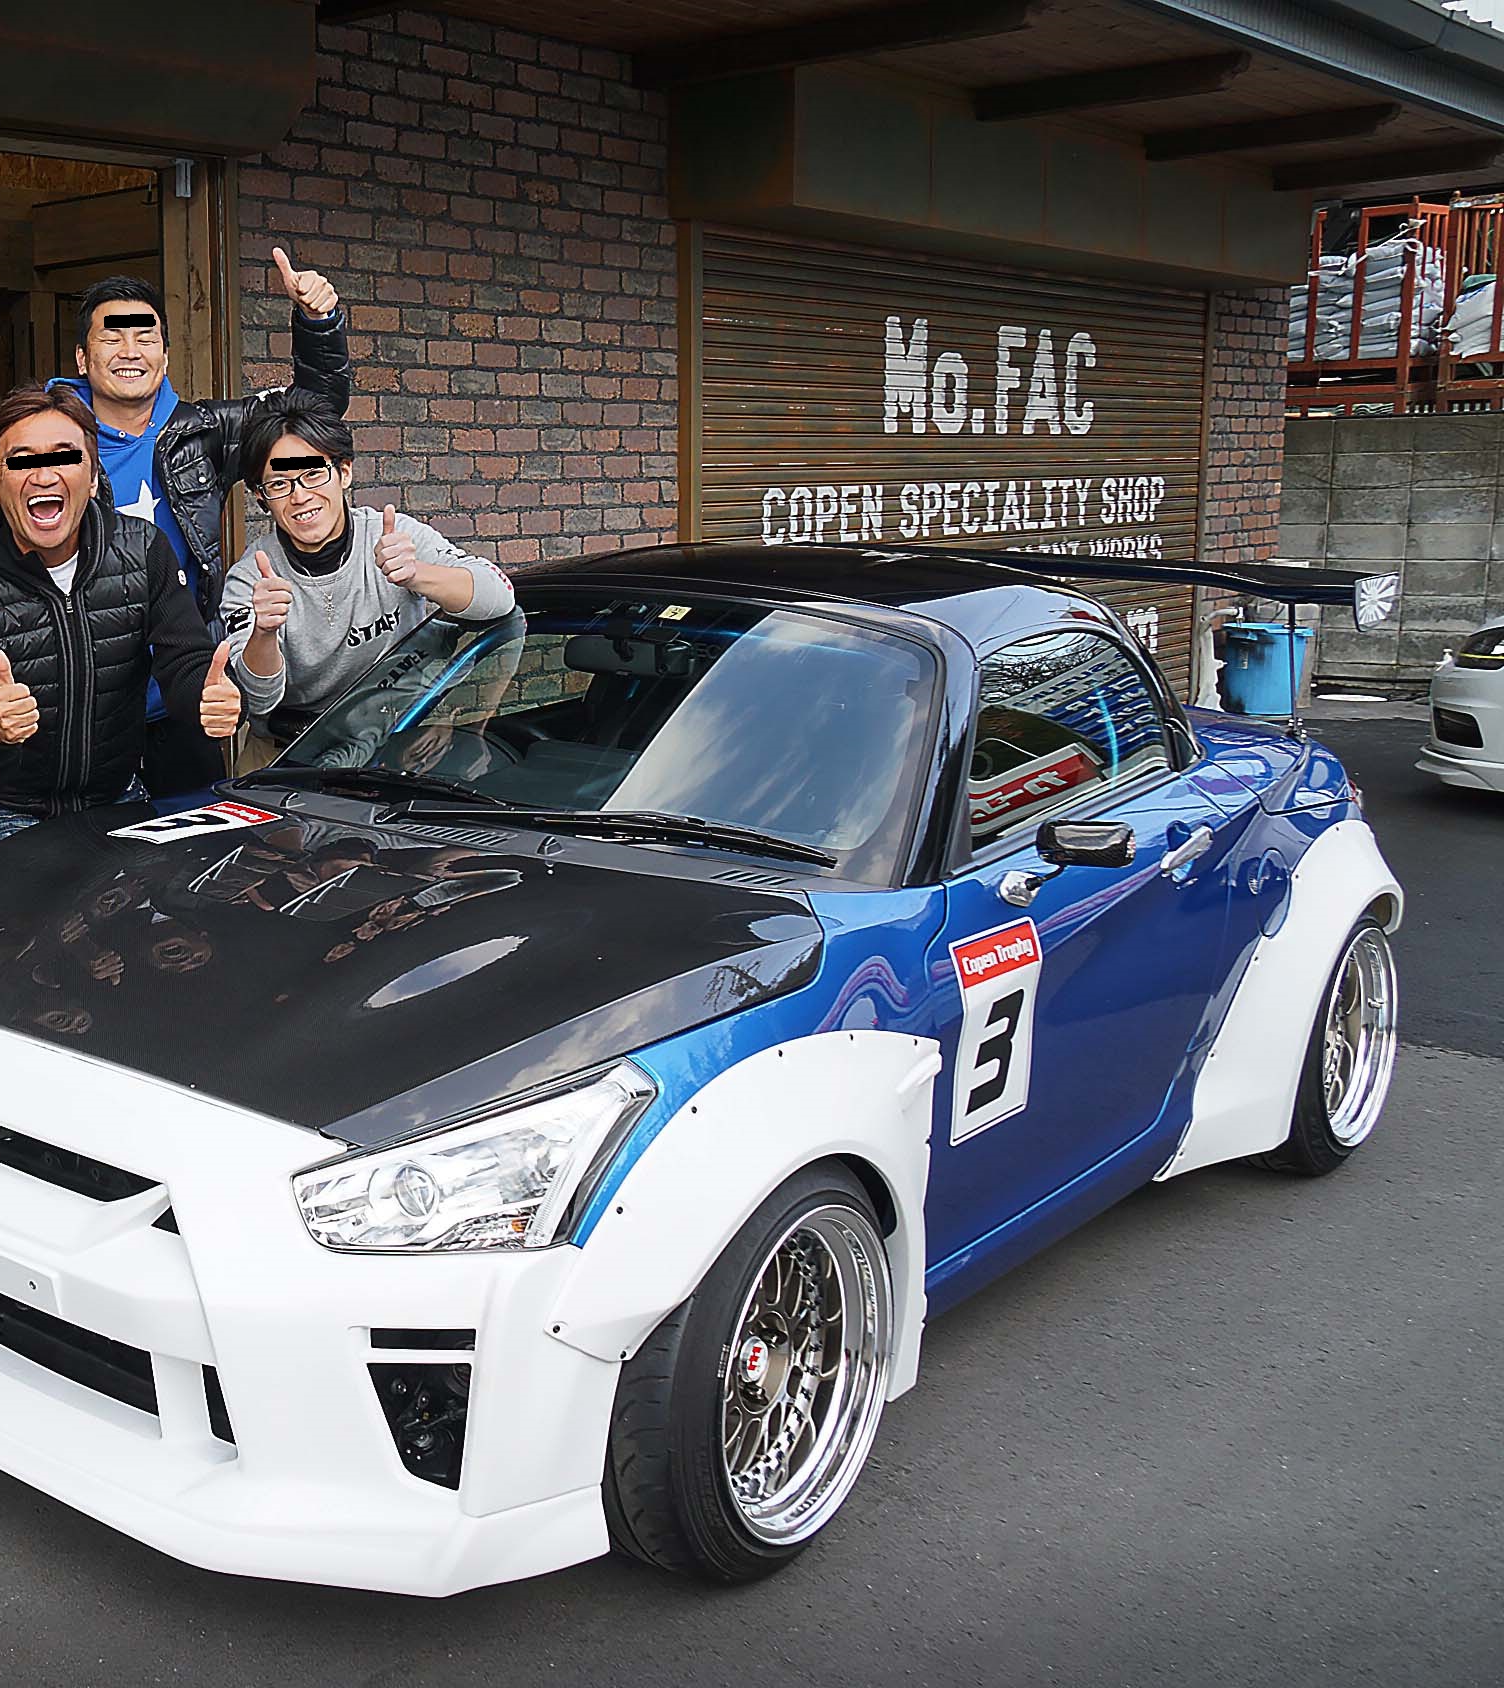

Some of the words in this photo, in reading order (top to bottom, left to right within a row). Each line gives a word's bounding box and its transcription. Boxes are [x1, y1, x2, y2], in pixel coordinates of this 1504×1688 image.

[883, 315, 1097, 436] Mo.FAC
[761, 484, 884, 546] COPEN
[899, 477, 1091, 538] SPECIALITY
[1100, 476, 1166, 525] SHOP
[963, 953, 998, 976] Copen
[995, 937, 1034, 964] Trophy
[965, 988, 1025, 1116] 3
